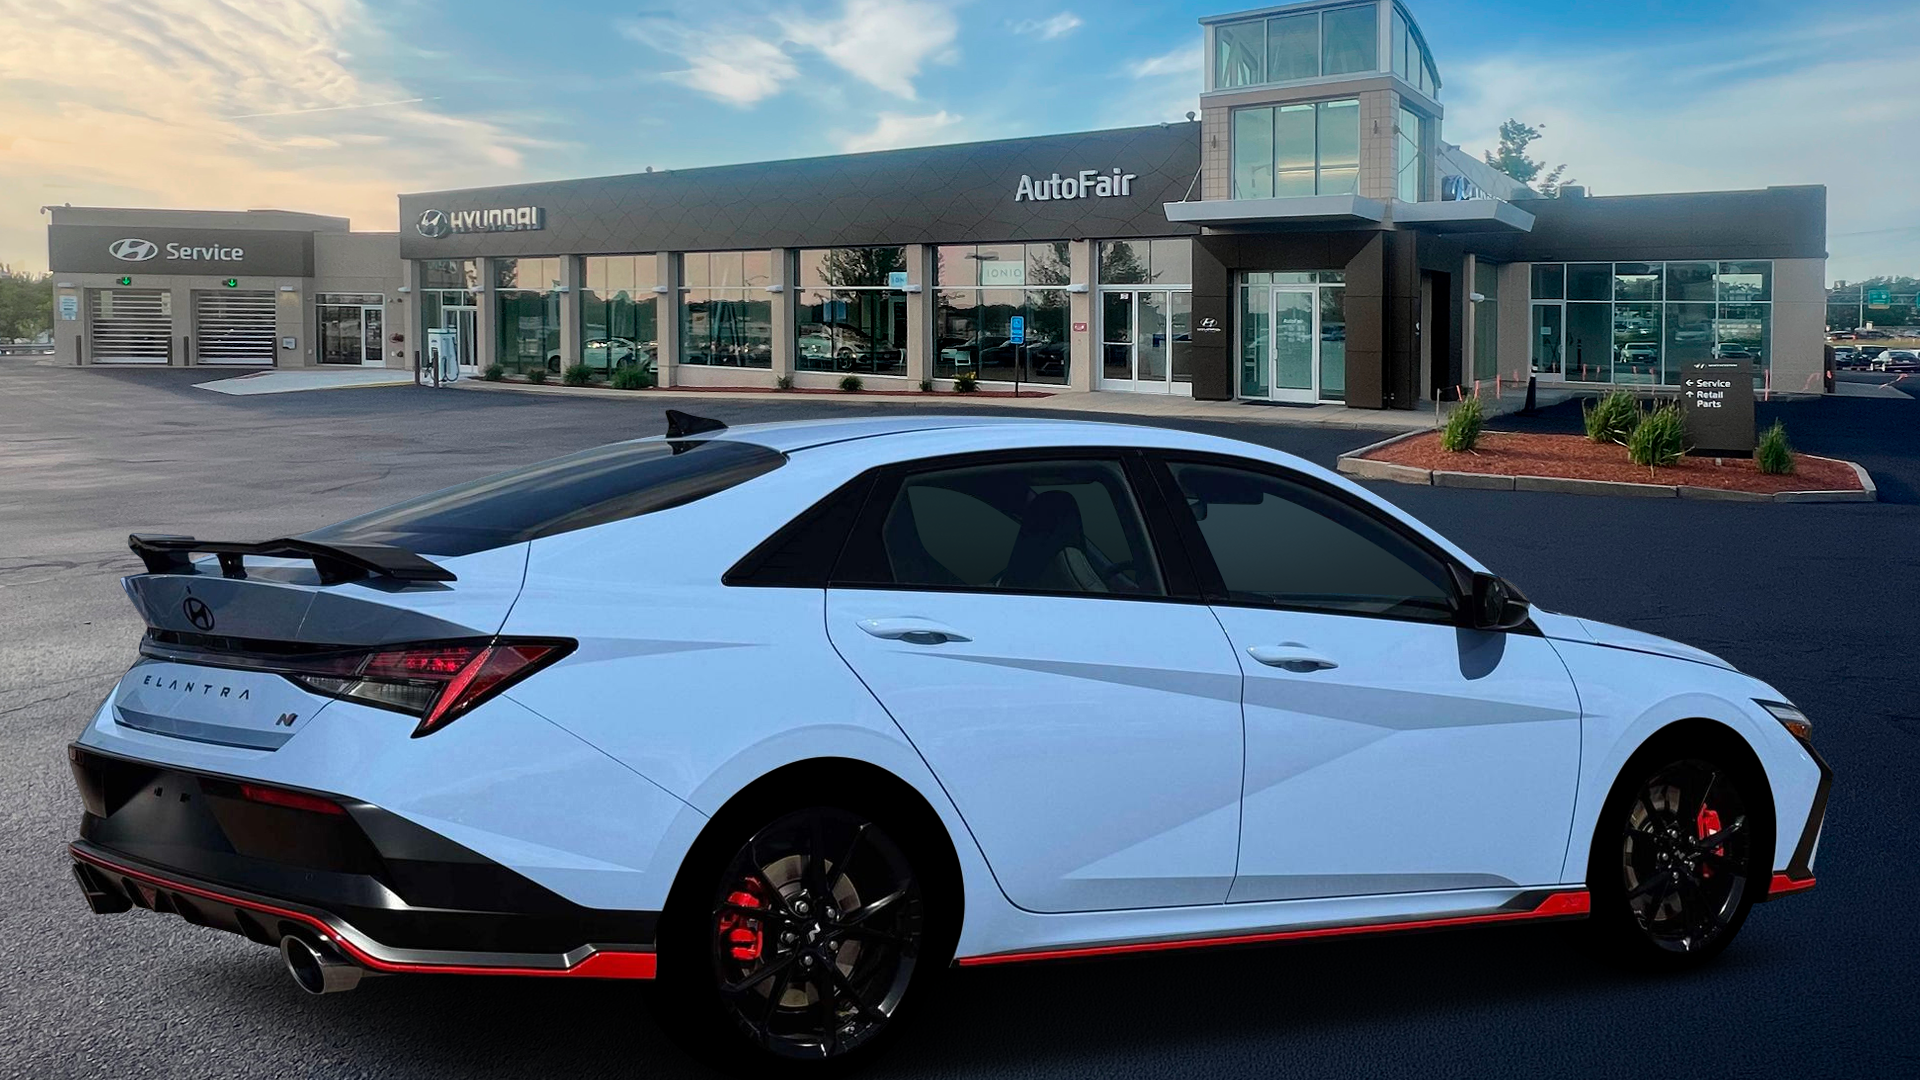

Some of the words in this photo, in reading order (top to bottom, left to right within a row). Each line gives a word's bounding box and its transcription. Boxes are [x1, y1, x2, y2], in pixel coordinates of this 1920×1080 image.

[1015, 167, 1138, 202] AutoFair
[450, 206, 542, 233] HYUNDAI
[166, 242, 244, 261] Service
[1696, 379, 1731, 388] Service
[1696, 390, 1724, 399] Retail
[1696, 400, 1722, 408] Parts
[143, 675, 250, 700] ELANTRA
